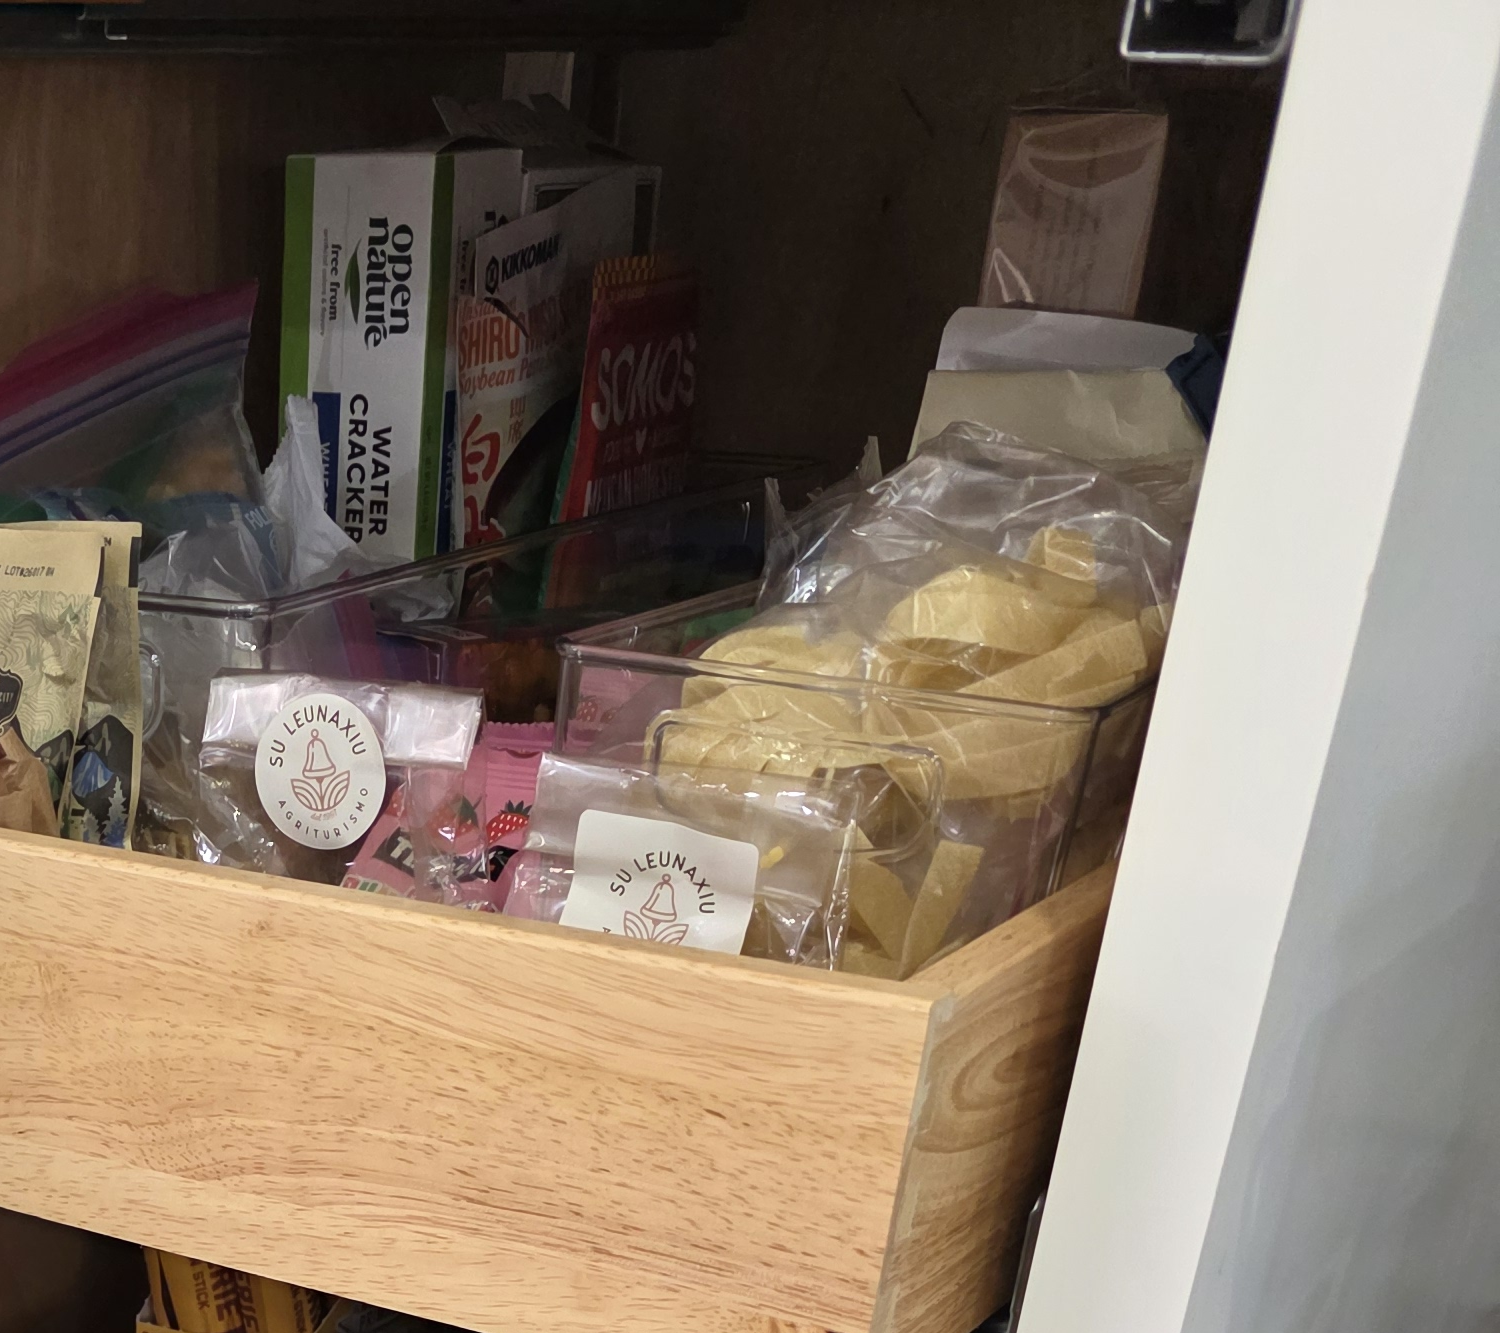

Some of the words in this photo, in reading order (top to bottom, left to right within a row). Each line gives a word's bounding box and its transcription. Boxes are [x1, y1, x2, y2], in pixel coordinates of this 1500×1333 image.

[330, 243, 343, 278] free
[363, 216, 390, 351] nature
[389, 224, 414, 336] open
[501, 233, 560, 282] KIKKOMAN
[329, 280, 341, 322] from
[591, 332, 696, 431] SOMOS
[345, 394, 369, 544] CRACKER
[368, 425, 393, 536] WATER
[268, 739, 286, 768] SU
[282, 706, 368, 758] LEUNAXIU
[277, 785, 371, 840] AGRITURISMO
[608, 866, 633, 898] SU
[633, 850, 716, 915] LEUNAXIU
